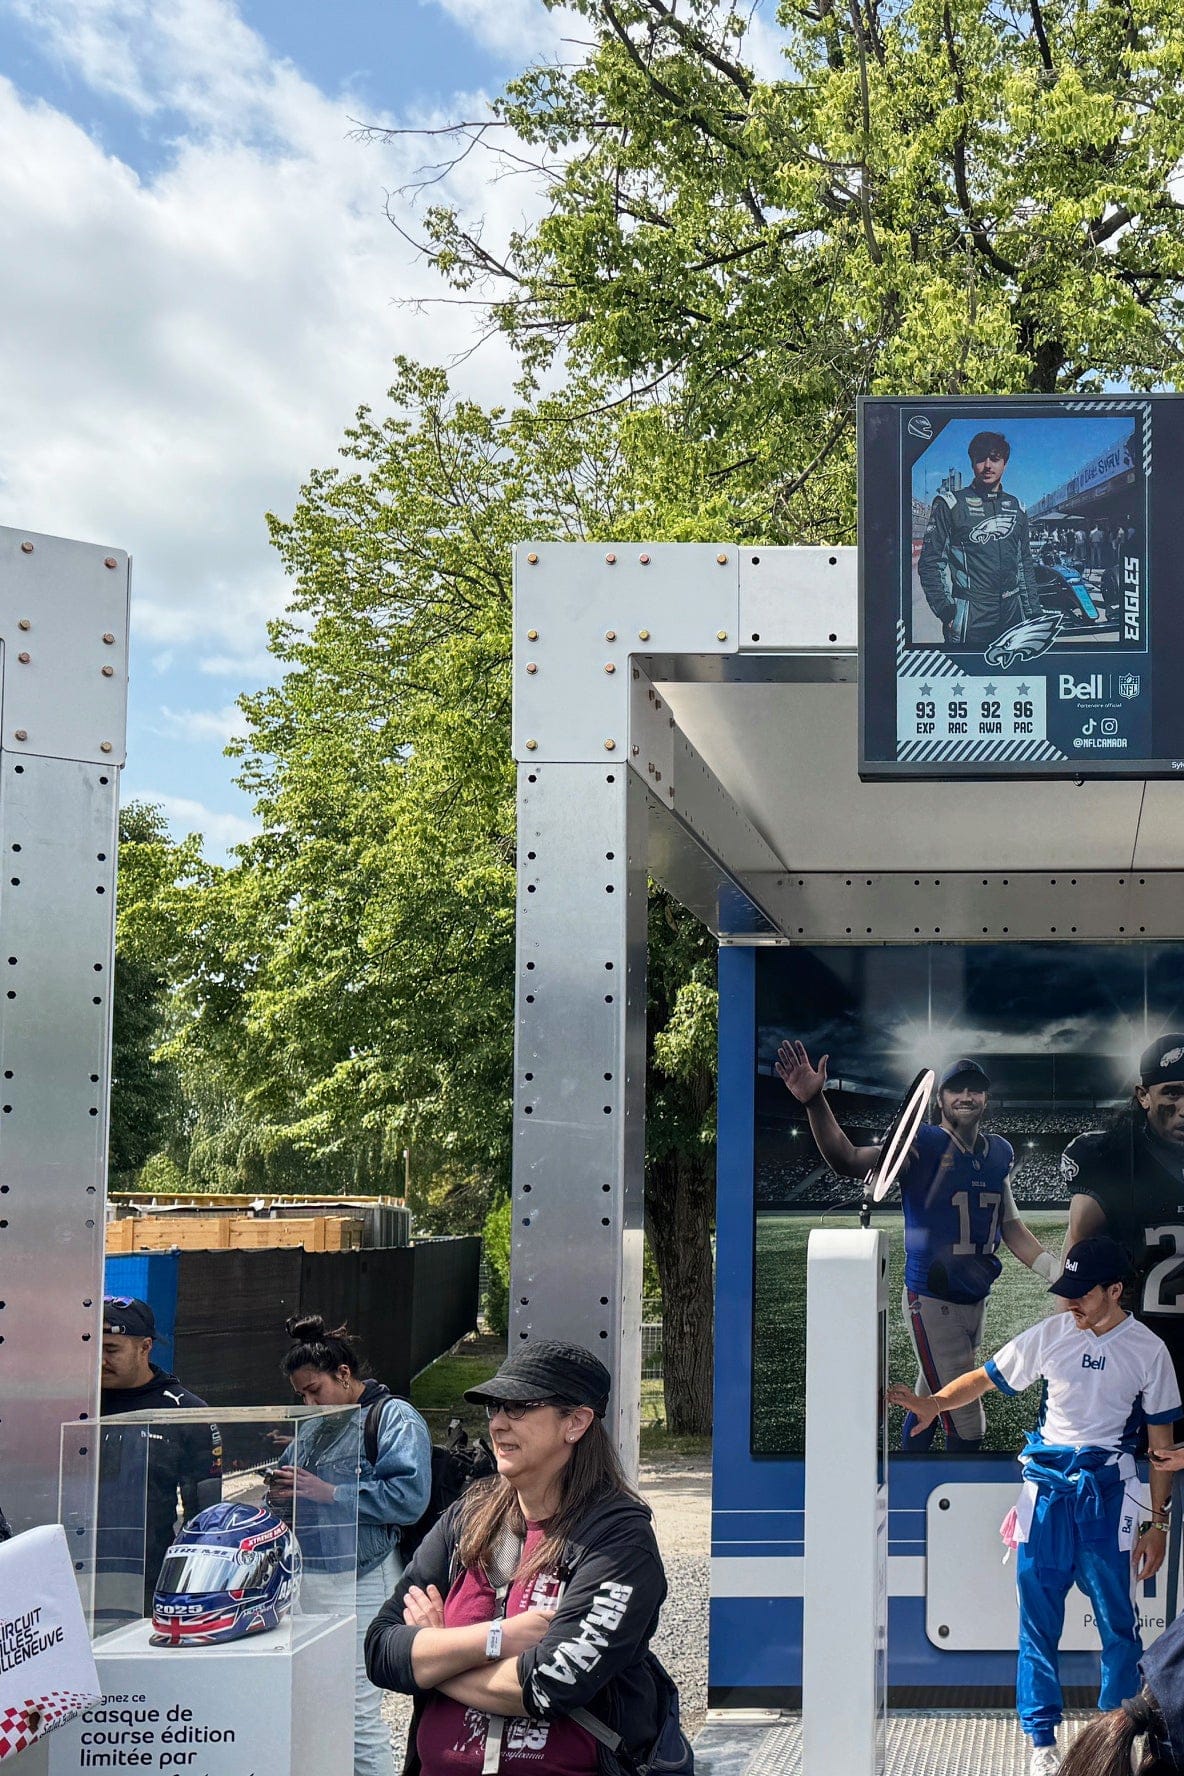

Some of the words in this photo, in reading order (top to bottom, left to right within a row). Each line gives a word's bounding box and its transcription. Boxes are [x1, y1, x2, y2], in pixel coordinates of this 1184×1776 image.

[1124, 556, 1140, 641] EAGLES
[1059, 674, 1103, 700] Bell
[915, 701, 936, 719] 93
[948, 701, 968, 719] 95
[981, 701, 1001, 719] 92
[1013, 701, 1034, 719] 96
[916, 722, 936, 735] EXP
[948, 722, 968, 734] RAC
[979, 722, 1002, 734] AWA
[1013, 722, 1034, 734] PAC
[1073, 738, 1128, 748] @NFLCANADA
[951, 1191, 1002, 1255] 17
[1065, 1258, 1079, 1273] Bell
[1081, 1354, 1106, 1371] Bell
[1121, 1516, 1133, 1534] Bell
[154, 1603, 203, 1615] 2025
[0, 1607, 42, 1642] IRCUIT
[132, 1694, 146, 1703] ce
[81, 1709, 160, 1727] casque
[166, 1704, 193, 1722] de
[80, 1730, 155, 1745] course
[161, 1726, 235, 1743] édition
[80, 1748, 153, 1767] limitée
[159, 1752, 198, 1769] par
